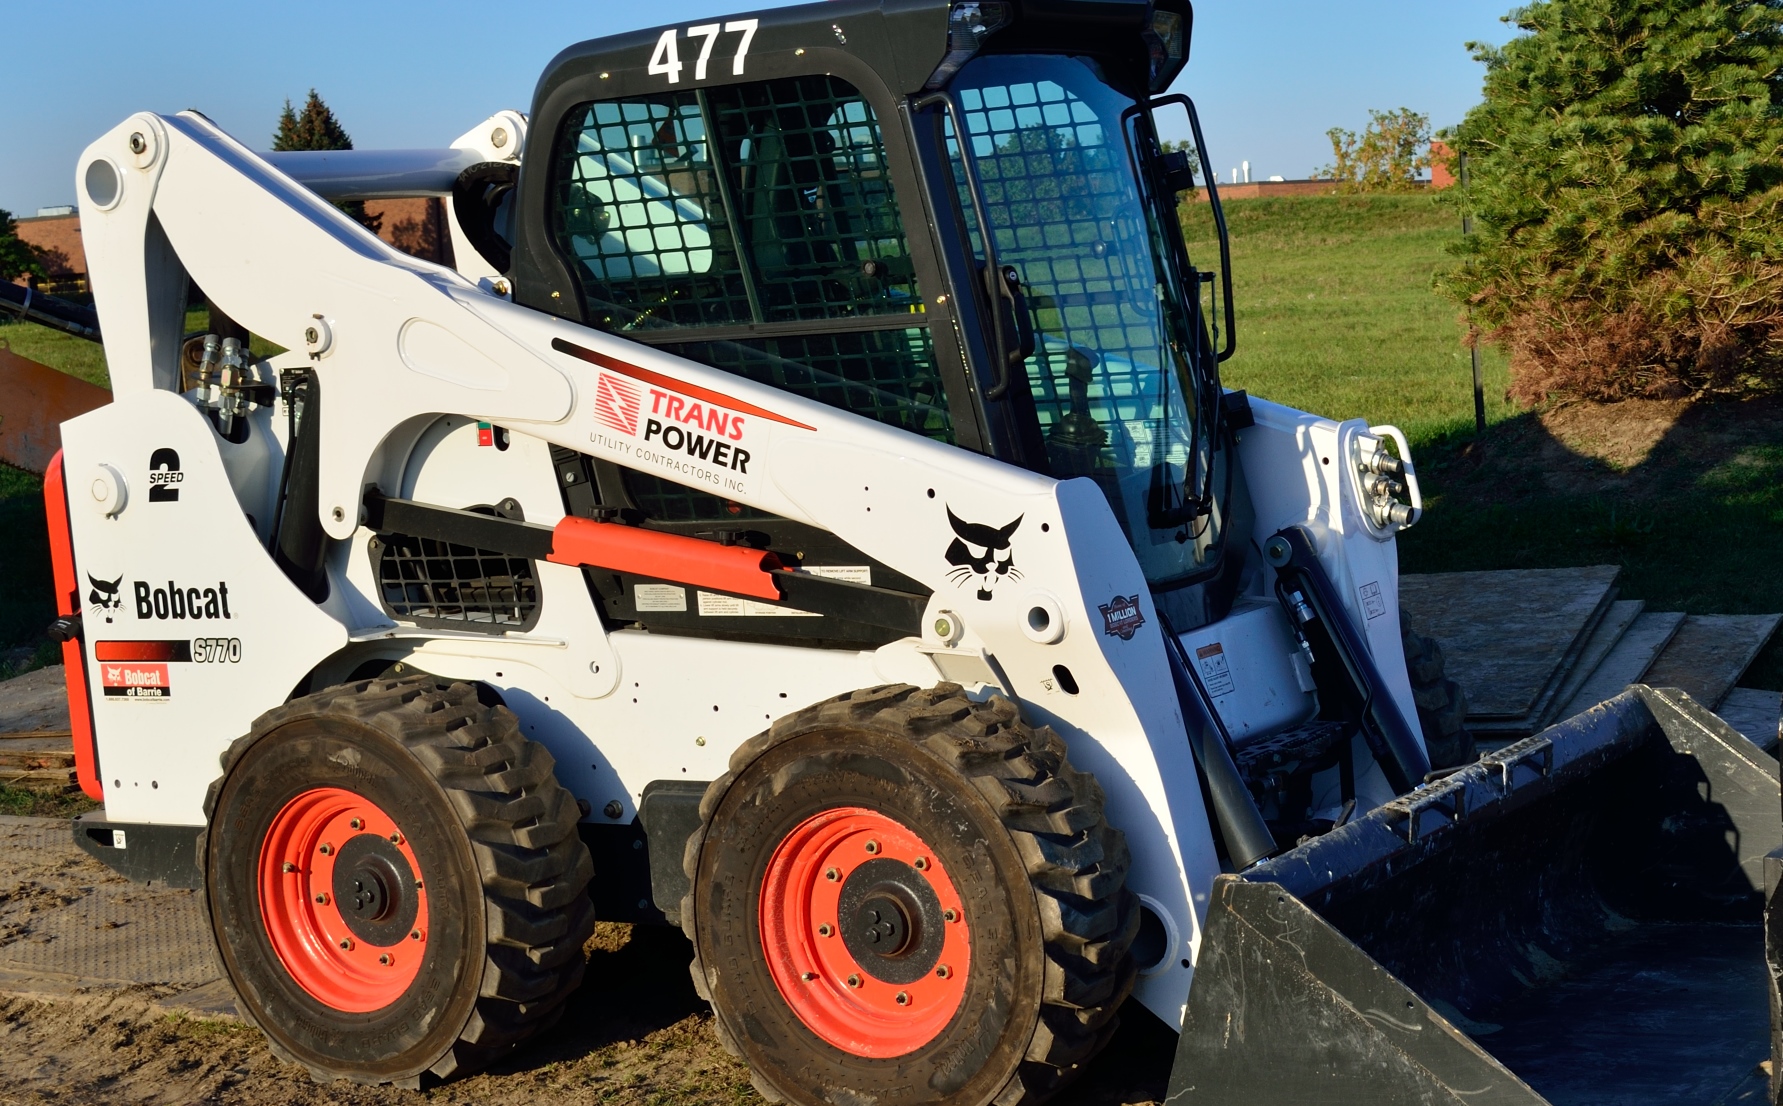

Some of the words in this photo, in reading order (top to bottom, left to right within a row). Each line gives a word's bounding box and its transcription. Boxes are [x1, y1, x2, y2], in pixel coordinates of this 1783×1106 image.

[648, 18, 759, 84] 477
[649, 388, 745, 441] TRANS
[589, 432, 632, 454] UTILITY
[635, 447, 720, 485] CONTRACTORS
[724, 478, 748, 495] INC.
[644, 418, 751, 474] POWER
[148, 447, 181, 503] 2
[149, 471, 184, 484] SPEED
[133, 580, 232, 620] Bobcat
[1111, 605, 1136, 621] MILLION
[193, 637, 242, 663] S770
[124, 669, 161, 685] Bobcat
[126, 687, 136, 696] of
[136, 687, 162, 696] Barrie
